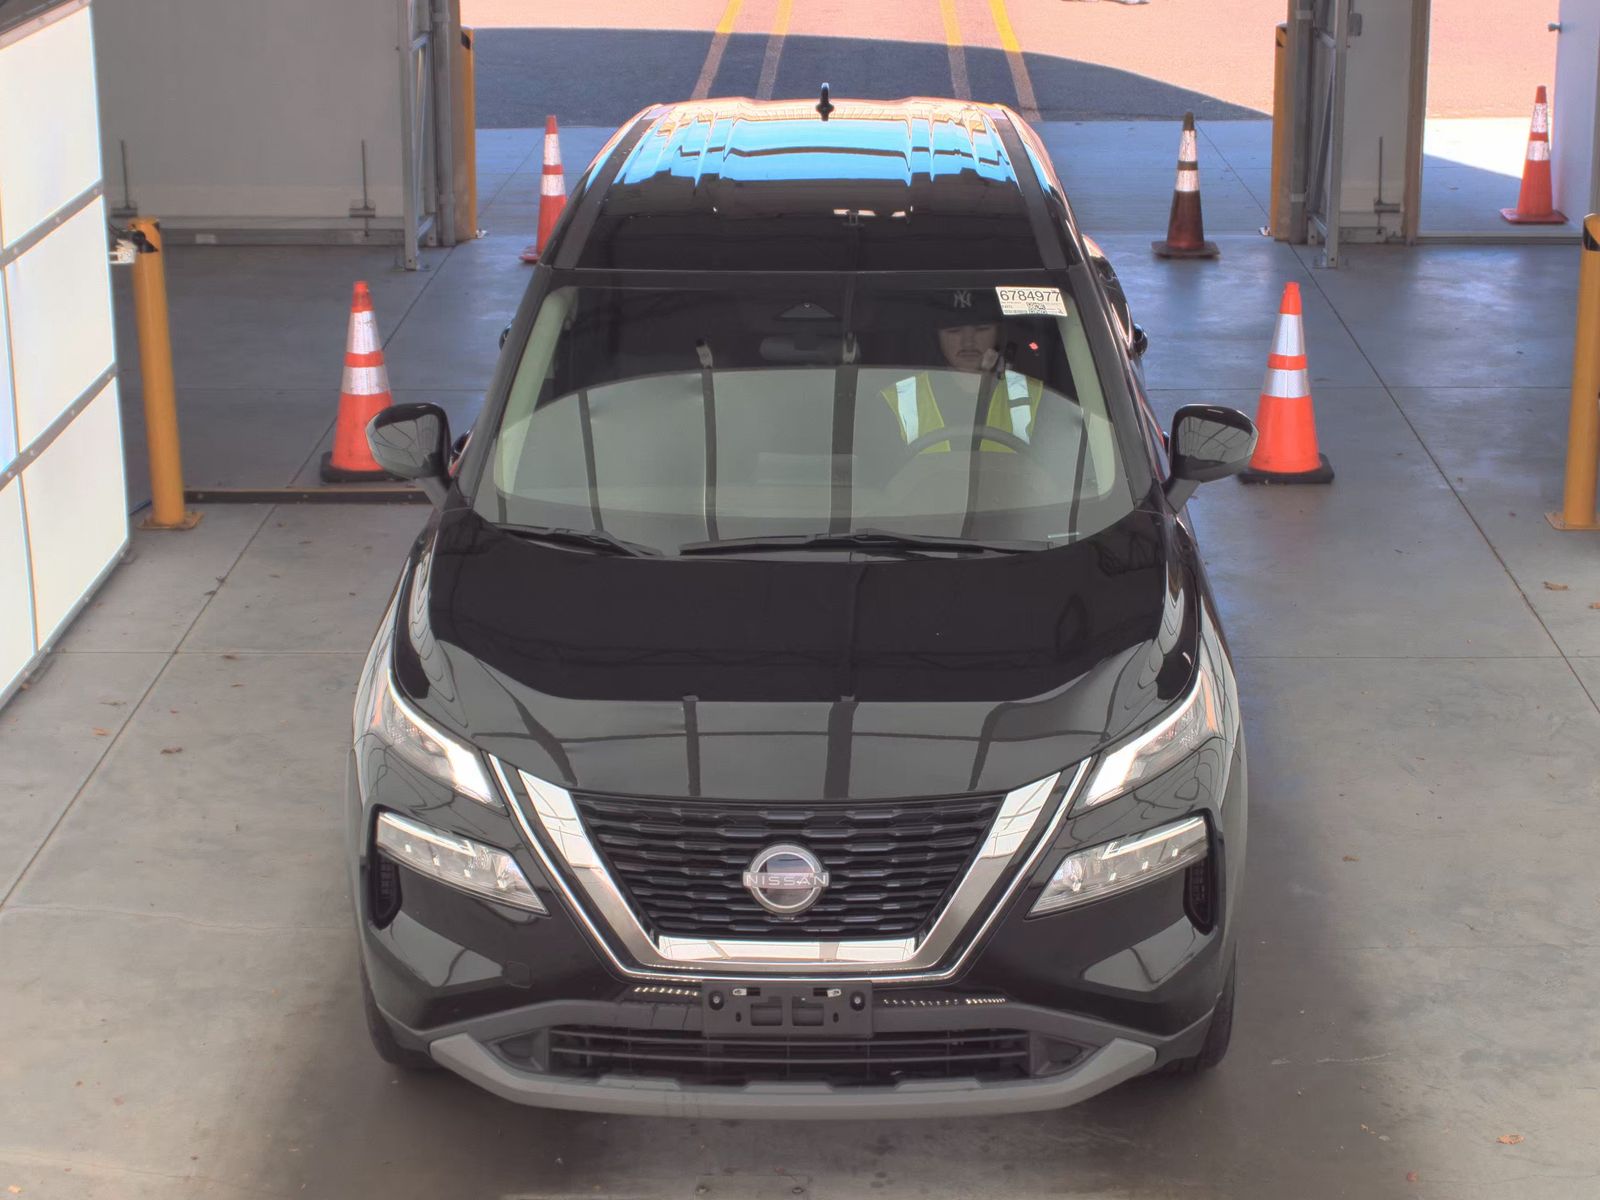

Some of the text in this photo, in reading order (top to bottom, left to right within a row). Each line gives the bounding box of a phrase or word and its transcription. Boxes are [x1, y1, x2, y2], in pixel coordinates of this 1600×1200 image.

[953, 290, 972, 308] NY
[1000, 290, 1060, 302] 6784977
[746, 874, 826, 887] NISSAN
